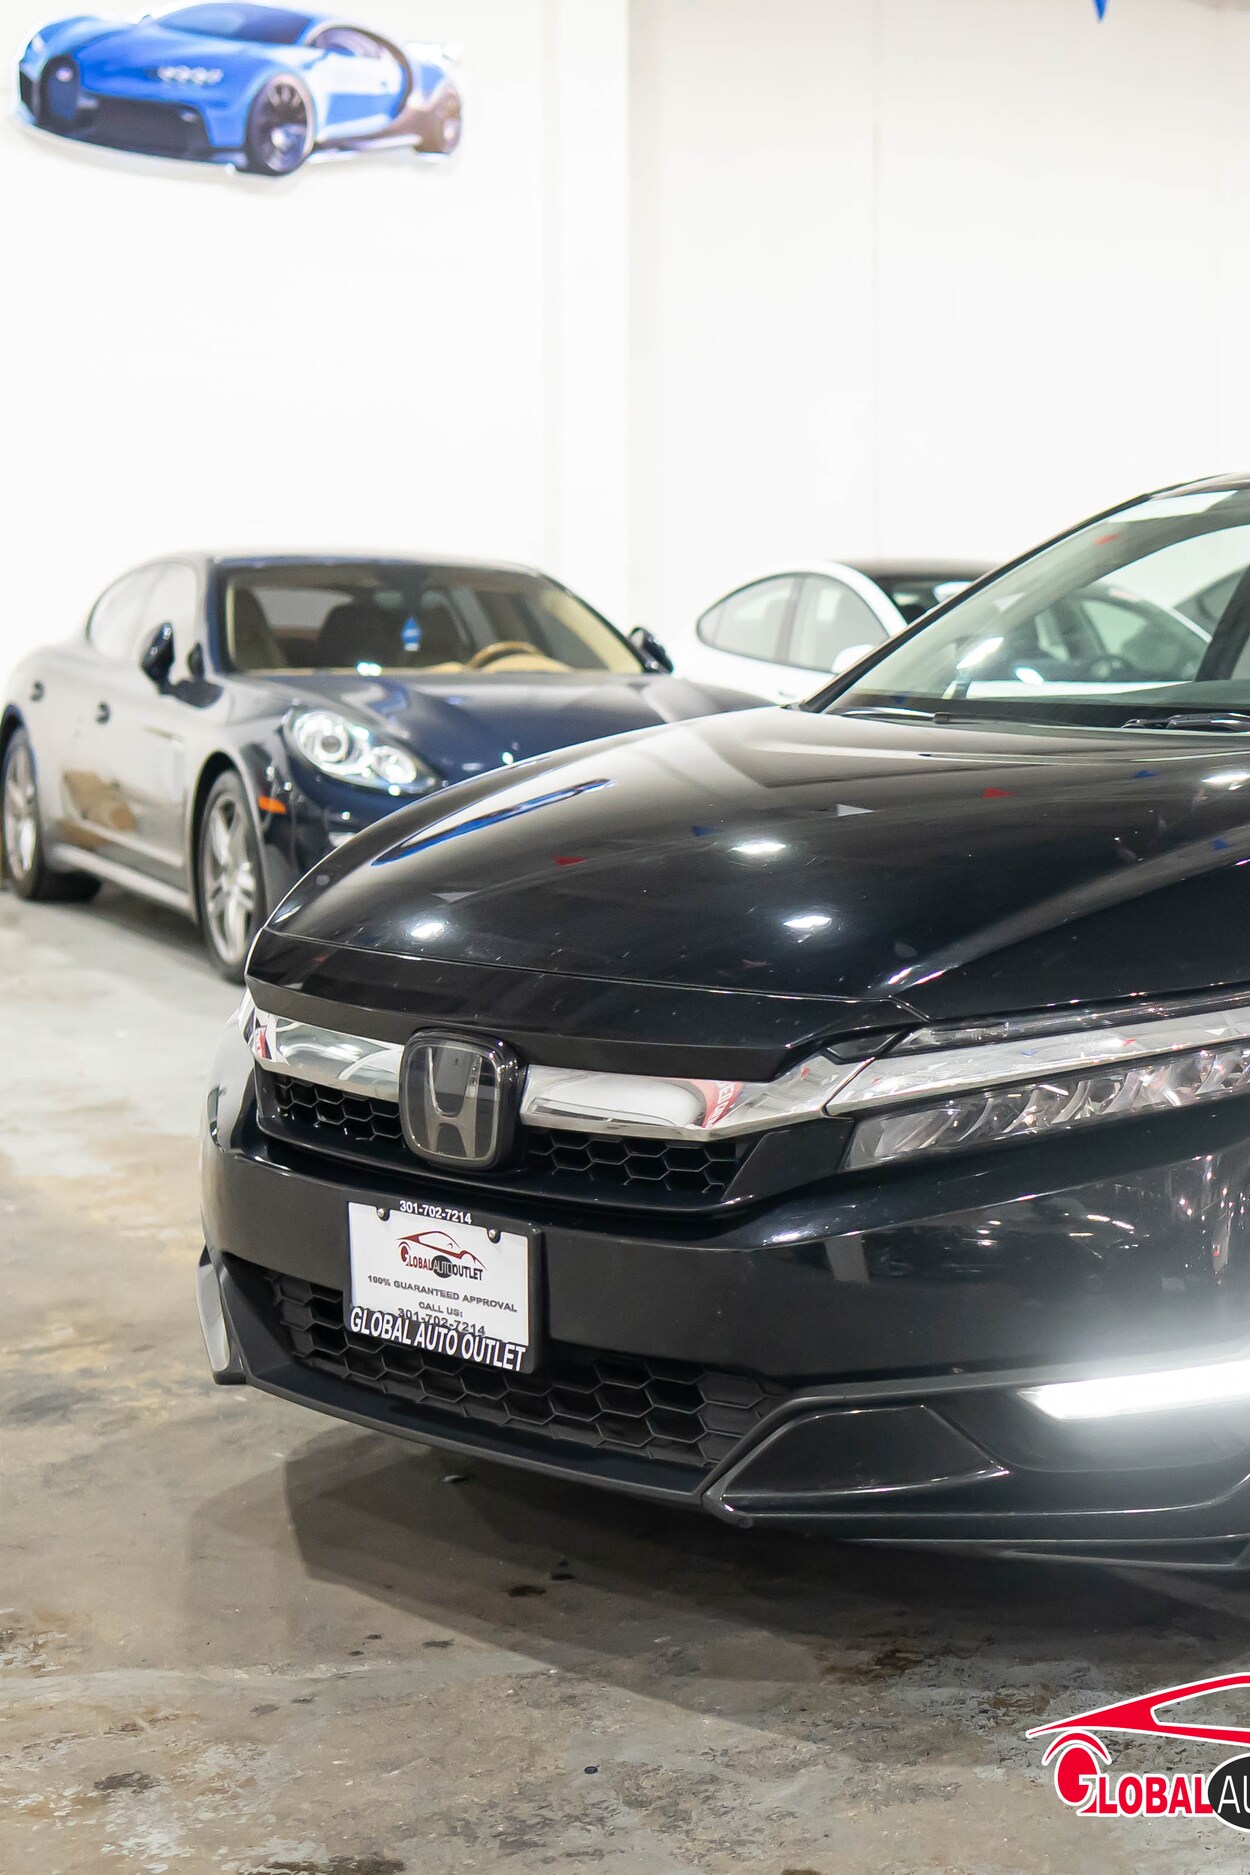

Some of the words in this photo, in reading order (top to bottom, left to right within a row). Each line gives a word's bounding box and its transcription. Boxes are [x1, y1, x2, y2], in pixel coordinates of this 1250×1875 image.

[400, 1200, 472, 1225] 301-702-7214
[400, 1246, 433, 1271] GLOBAL
[452, 1263, 483, 1281] OUTLET
[368, 1275, 391, 1287] 100%
[393, 1280, 460, 1301] GUARANTEED
[462, 1294, 518, 1313] APPROVAL
[418, 1301, 444, 1314] CALL
[446, 1306, 463, 1318] US:
[351, 1307, 412, 1345] GLOBAL
[413, 1323, 458, 1356] AUTO
[461, 1334, 526, 1372] OUTLET
